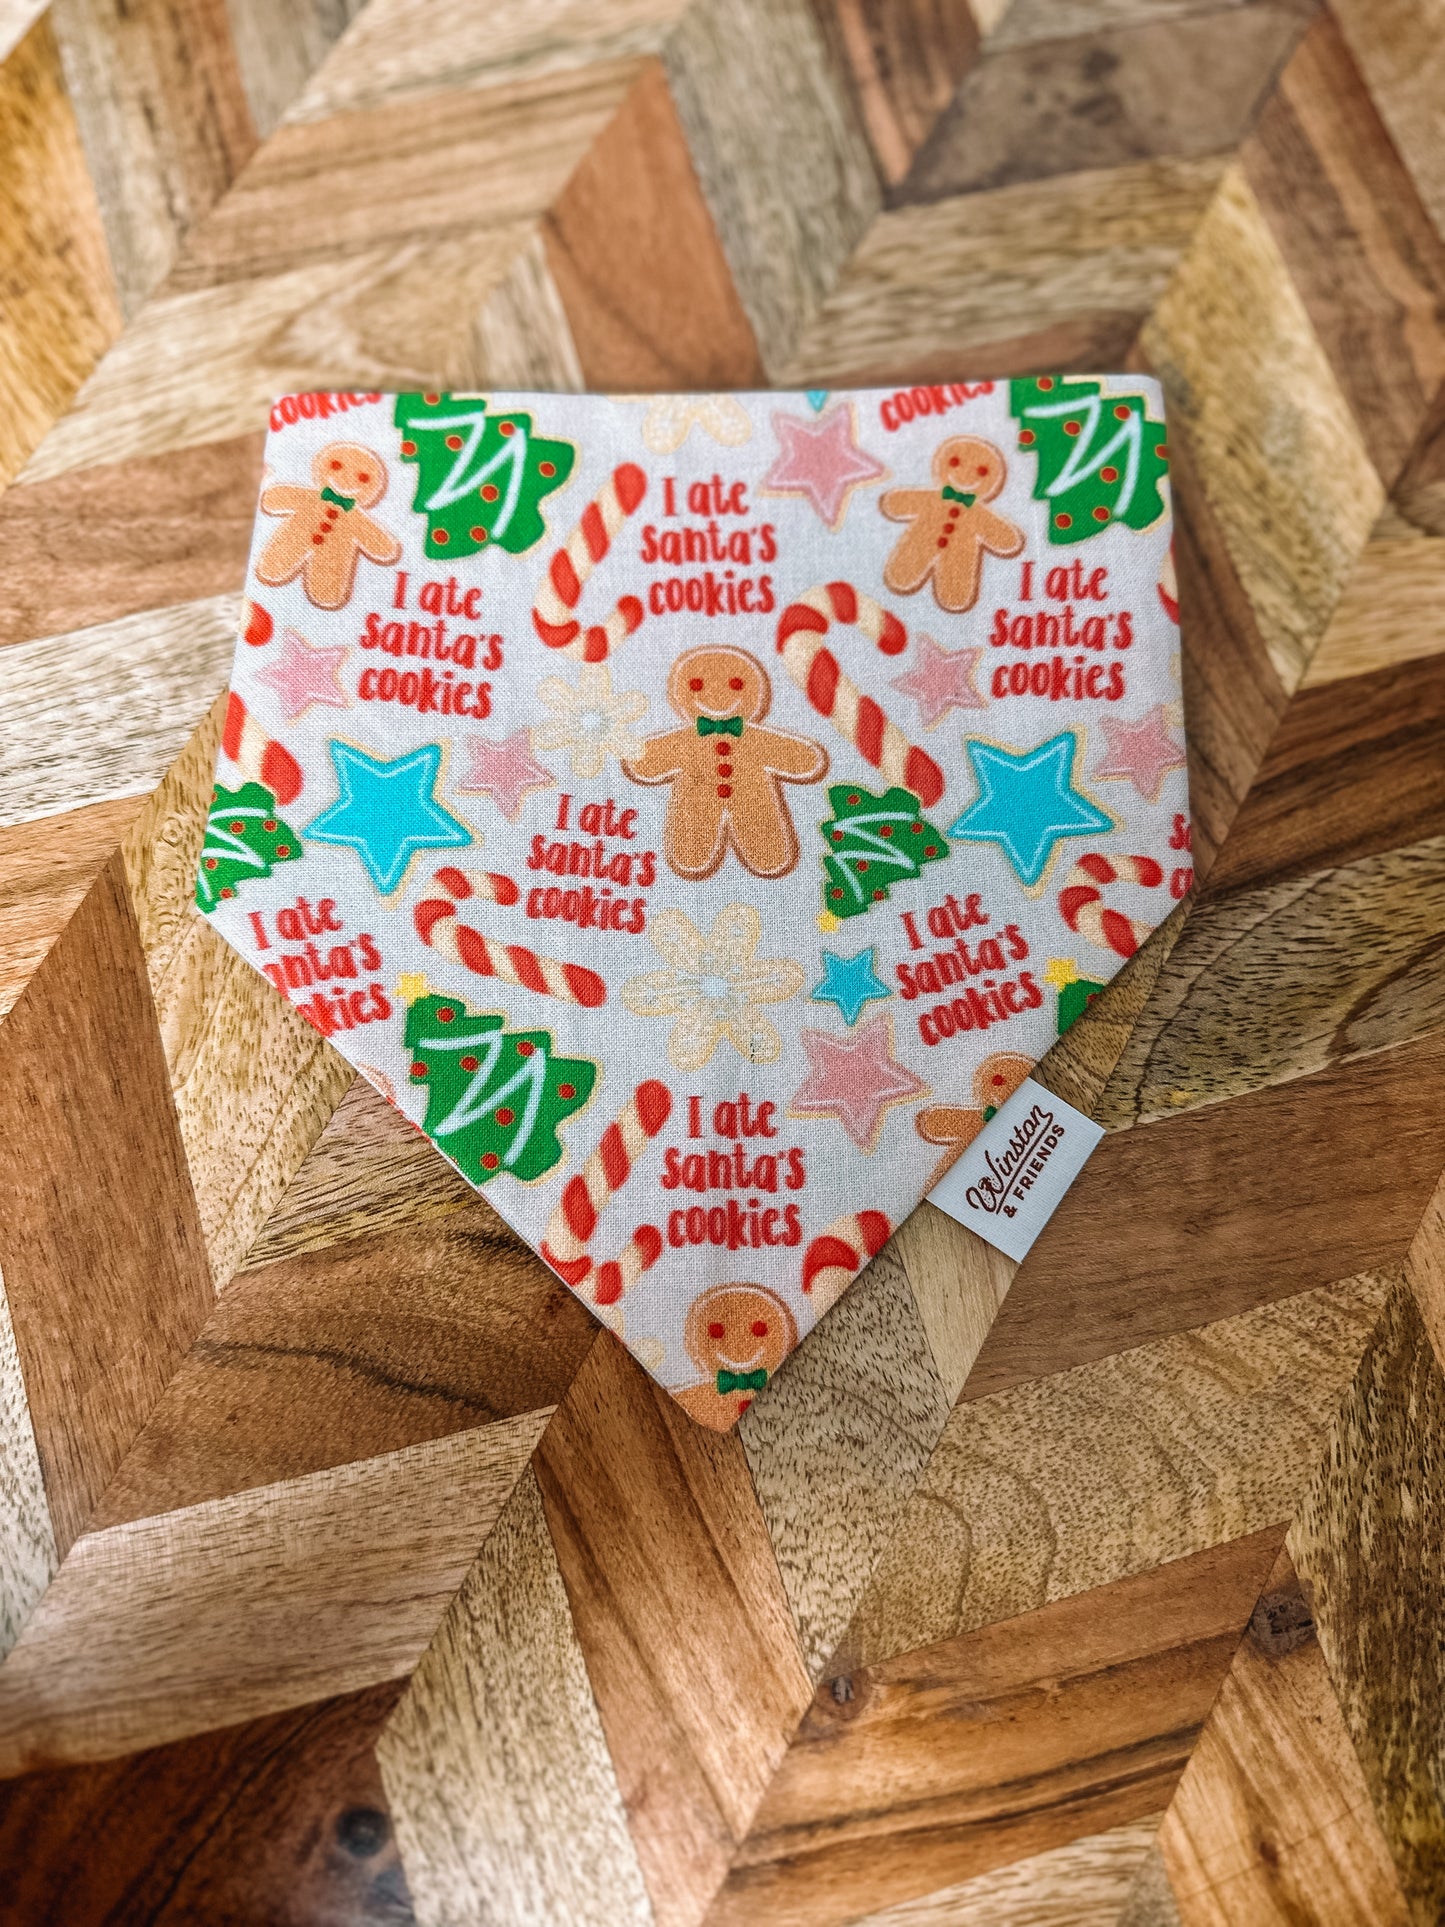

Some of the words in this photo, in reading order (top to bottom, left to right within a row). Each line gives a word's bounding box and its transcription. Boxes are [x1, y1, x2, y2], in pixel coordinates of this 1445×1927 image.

[662, 477, 678, 517] I
[687, 473, 749, 517] ate
[393, 571, 408, 610] I
[418, 576, 483, 621] ate
[649, 569, 776, 617] cookies
[1019, 561, 1035, 602] I
[1044, 559, 1108, 603] ate
[357, 667, 493, 720] cookies
[991, 654, 1125, 702] cookies
[555, 793, 572, 831] I
[578, 798, 639, 840] ate
[247, 911, 272, 951] I
[276, 896, 343, 941] ate
[525, 885, 646, 935] cookies
[901, 911, 924, 951] I
[927, 893, 989, 939] ate
[918, 970, 1043, 1047] cookies
[686, 1095, 704, 1139] I
[712, 1092, 777, 1140] ate
[965, 1104, 1053, 1214] Winston
[1002, 1204, 1018, 1218] &
[1012, 1124, 1065, 1201] FRIENDS
[666, 1198, 803, 1251] cookies
